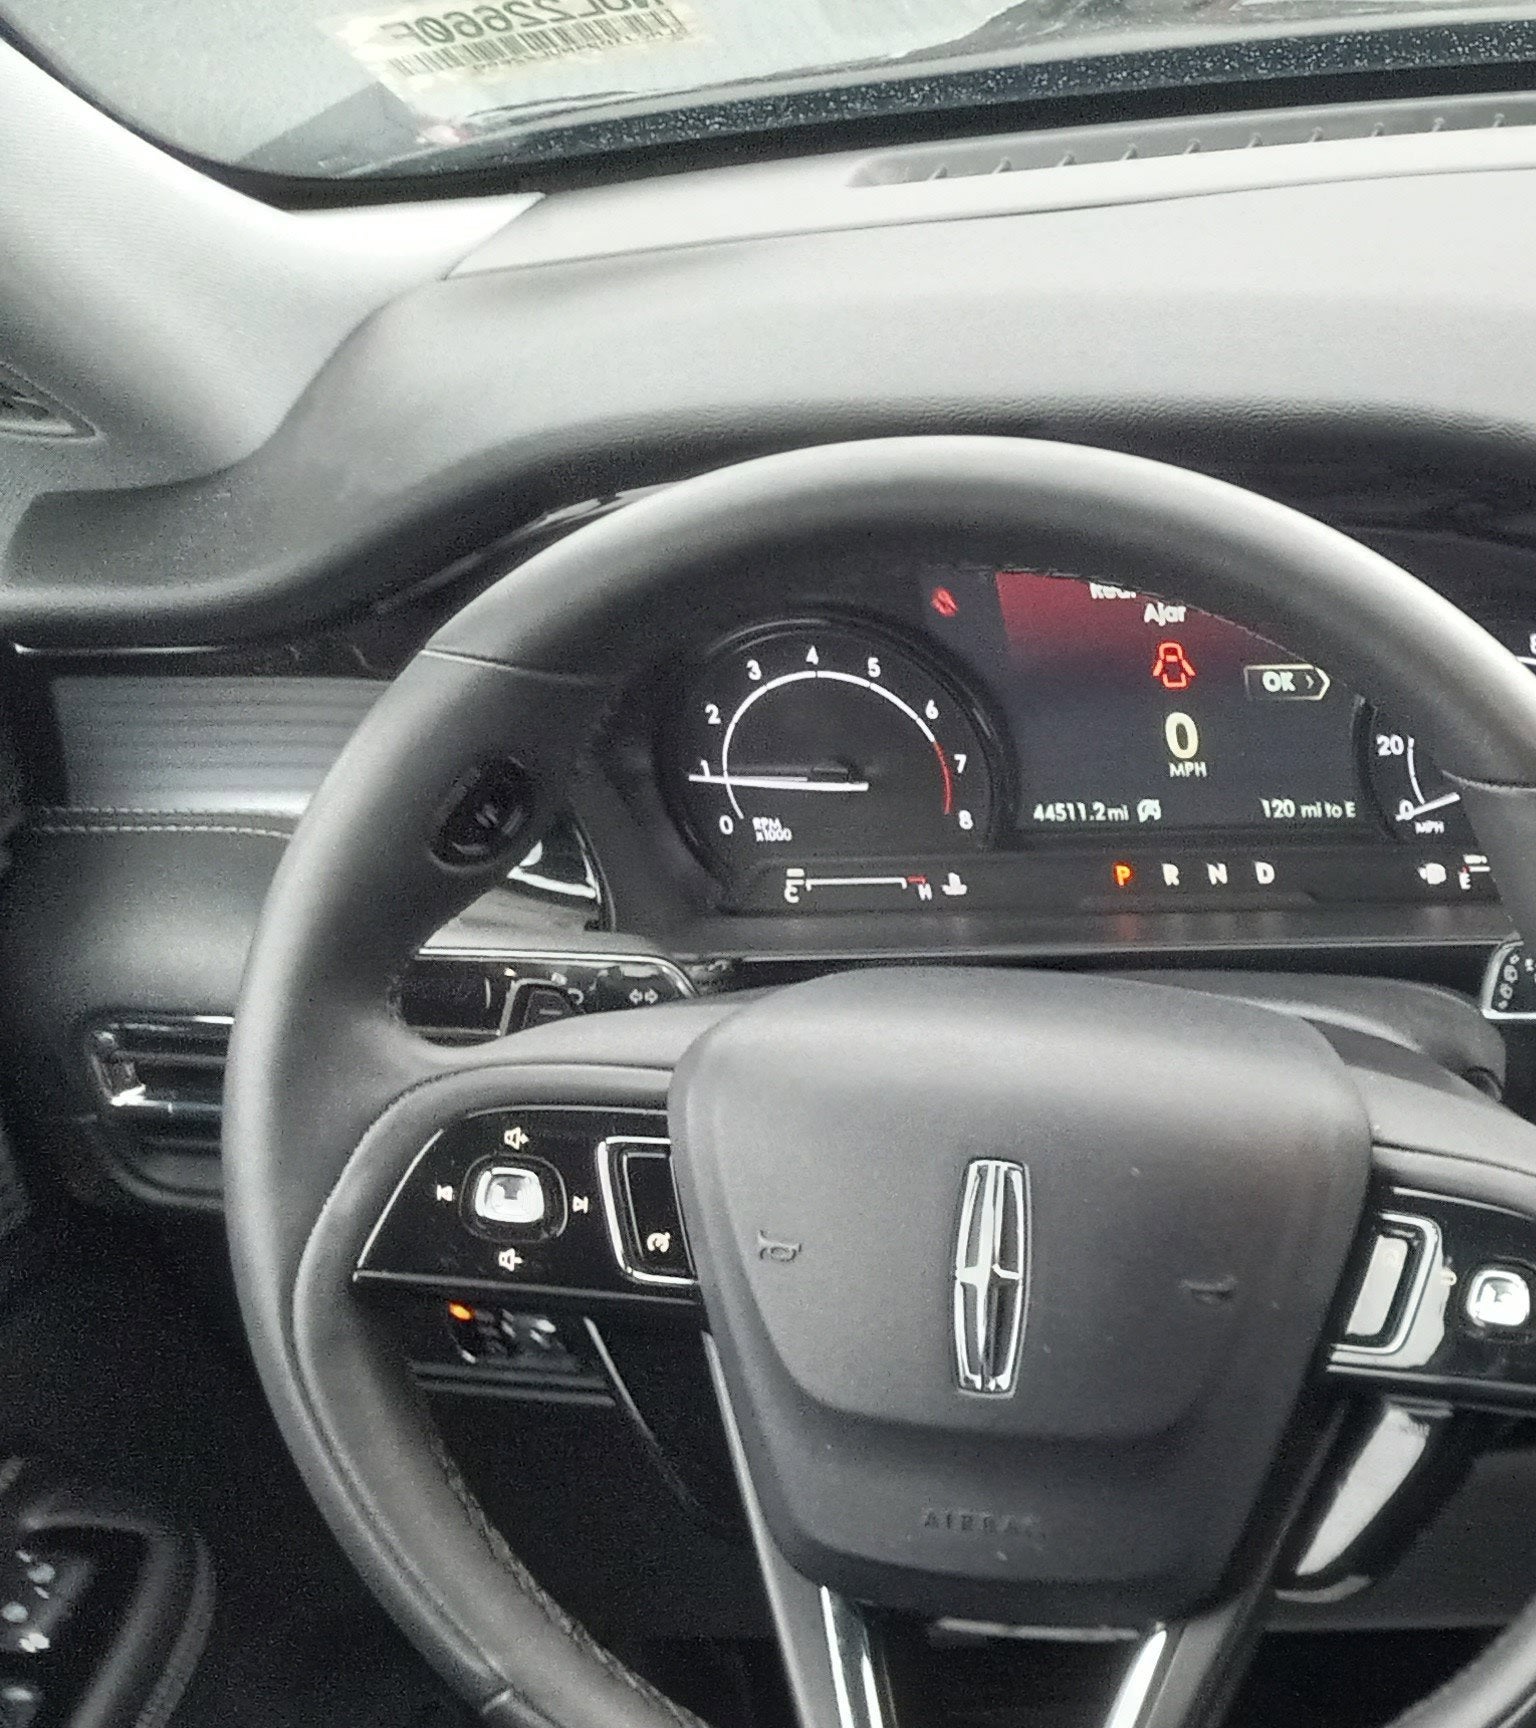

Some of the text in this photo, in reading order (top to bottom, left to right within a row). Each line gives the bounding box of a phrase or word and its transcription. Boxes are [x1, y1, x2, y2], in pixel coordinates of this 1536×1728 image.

[1143, 602, 1187, 626] Ajar
[805, 645, 819, 665] 4
[746, 659, 762, 681] 3
[867, 657, 881, 678] 5
[1262, 670, 1296, 693] OK
[704, 703, 722, 725] 2
[925, 699, 939, 720] 6
[1165, 712, 1199, 759] 0
[1376, 734, 1404, 756] 20
[954, 753, 967, 773] 7
[1169, 762, 1207, 777] MPH
[1261, 798, 1295, 818] 120
[1345, 801, 1357, 818] E
[719, 815, 734, 835] 0
[752, 817, 782, 831] RPM
[958, 810, 973, 831] 8
[1115, 861, 1275, 886] P R N D
